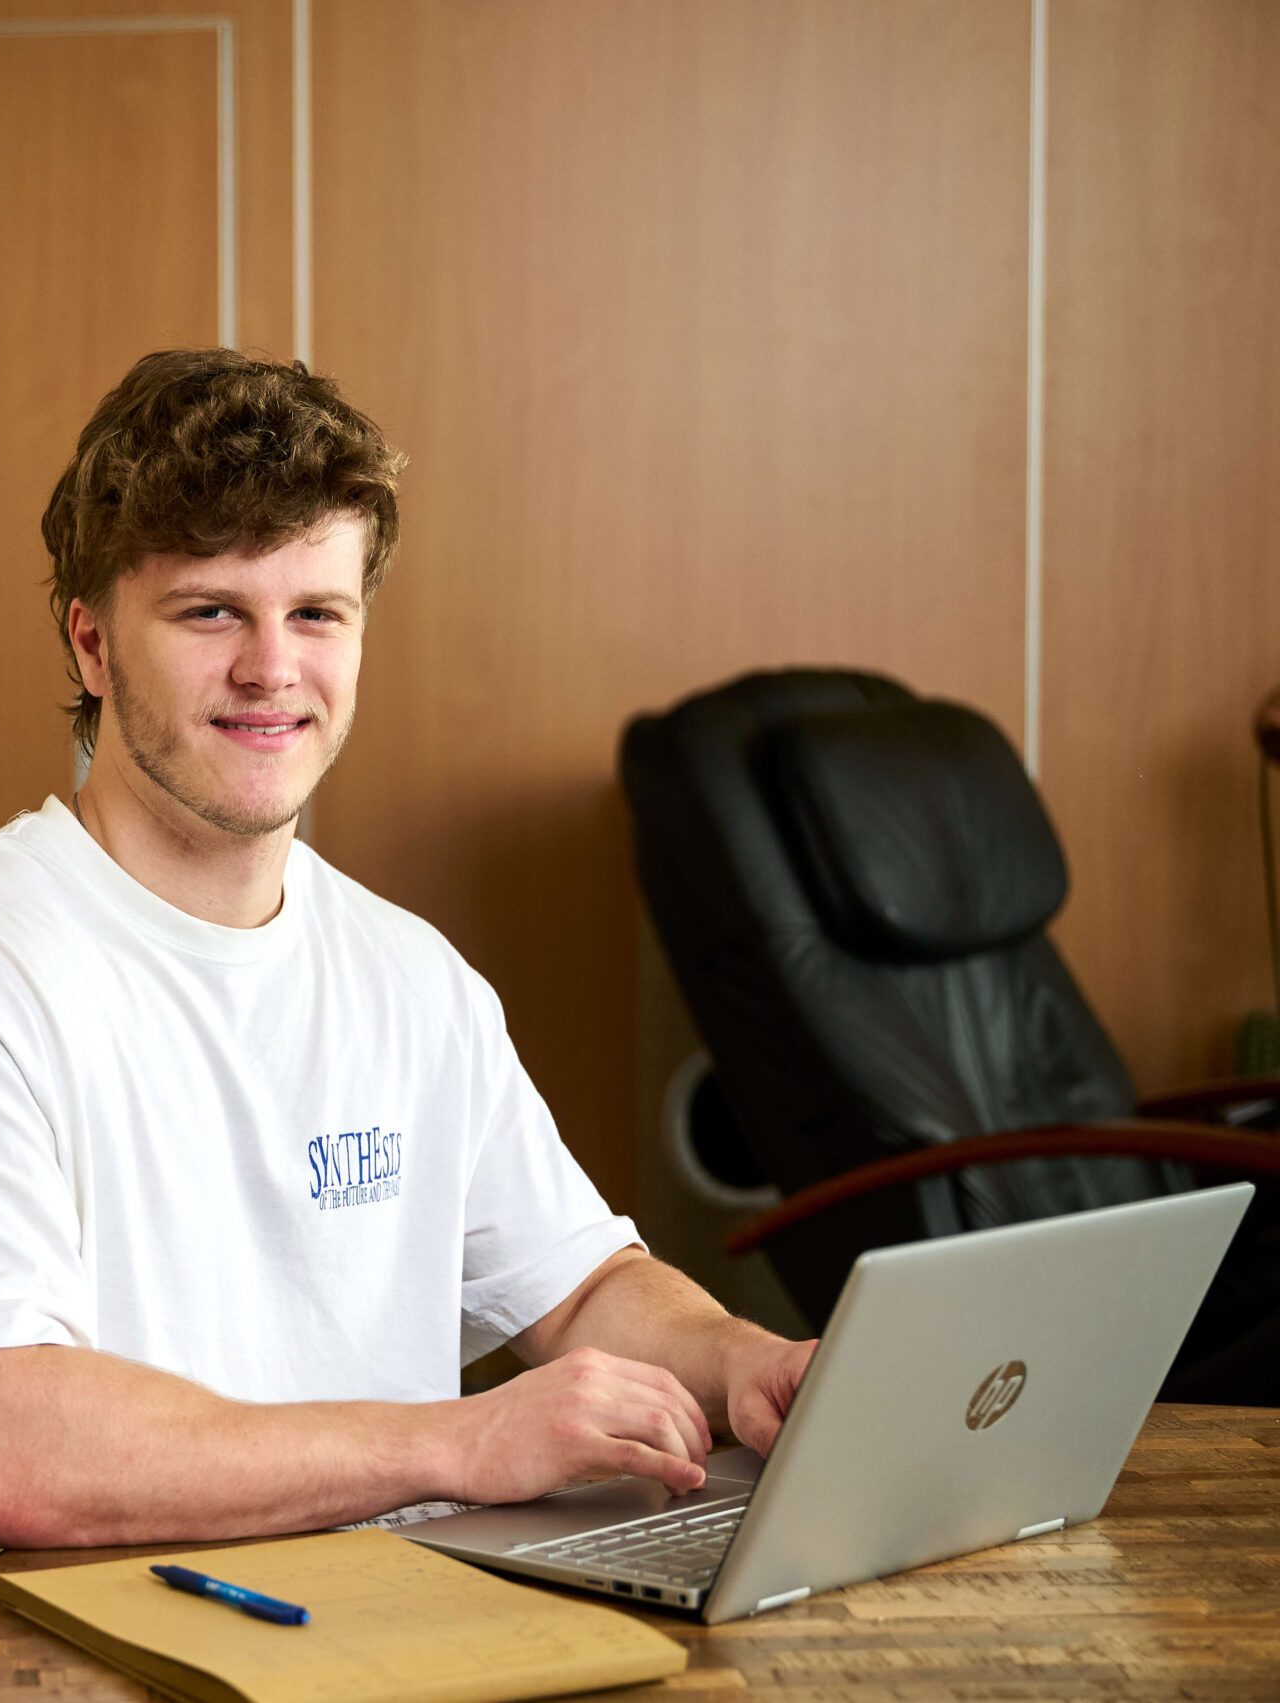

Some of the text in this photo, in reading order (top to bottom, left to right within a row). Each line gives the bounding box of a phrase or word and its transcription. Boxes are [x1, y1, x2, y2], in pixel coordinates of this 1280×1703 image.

[319, 1190, 328, 1211] OF
[328, 1189, 341, 1210] THE
[342, 1185, 368, 1207] FUTURE
[369, 1182, 382, 1203] AND
